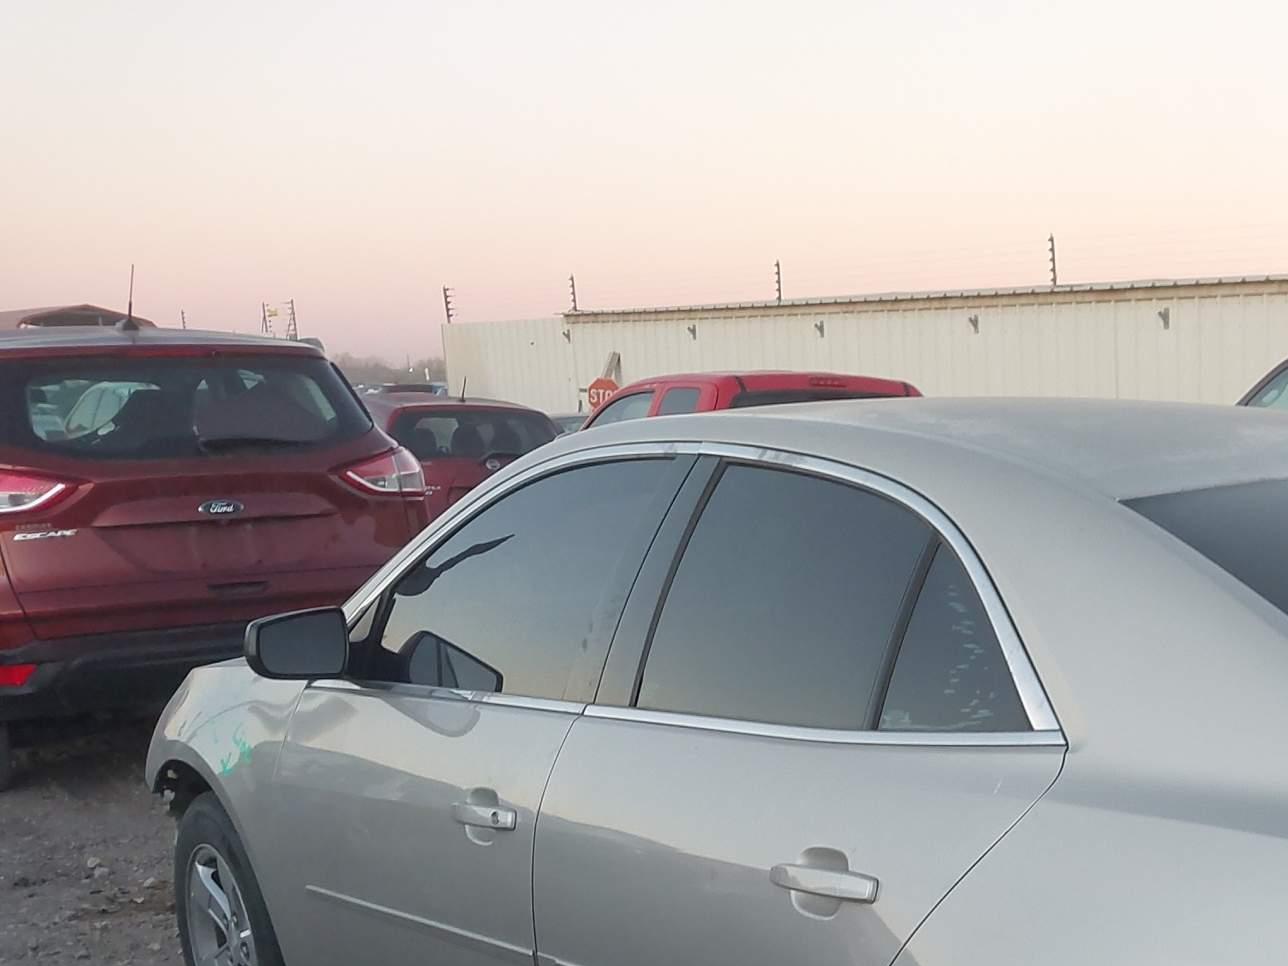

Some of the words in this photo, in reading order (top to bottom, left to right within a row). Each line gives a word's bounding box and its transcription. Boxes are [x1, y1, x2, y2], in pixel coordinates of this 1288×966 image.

[589, 388, 615, 403] STO
[210, 501, 235, 514] Ford
[12, 528, 78, 541] ESCAPE
